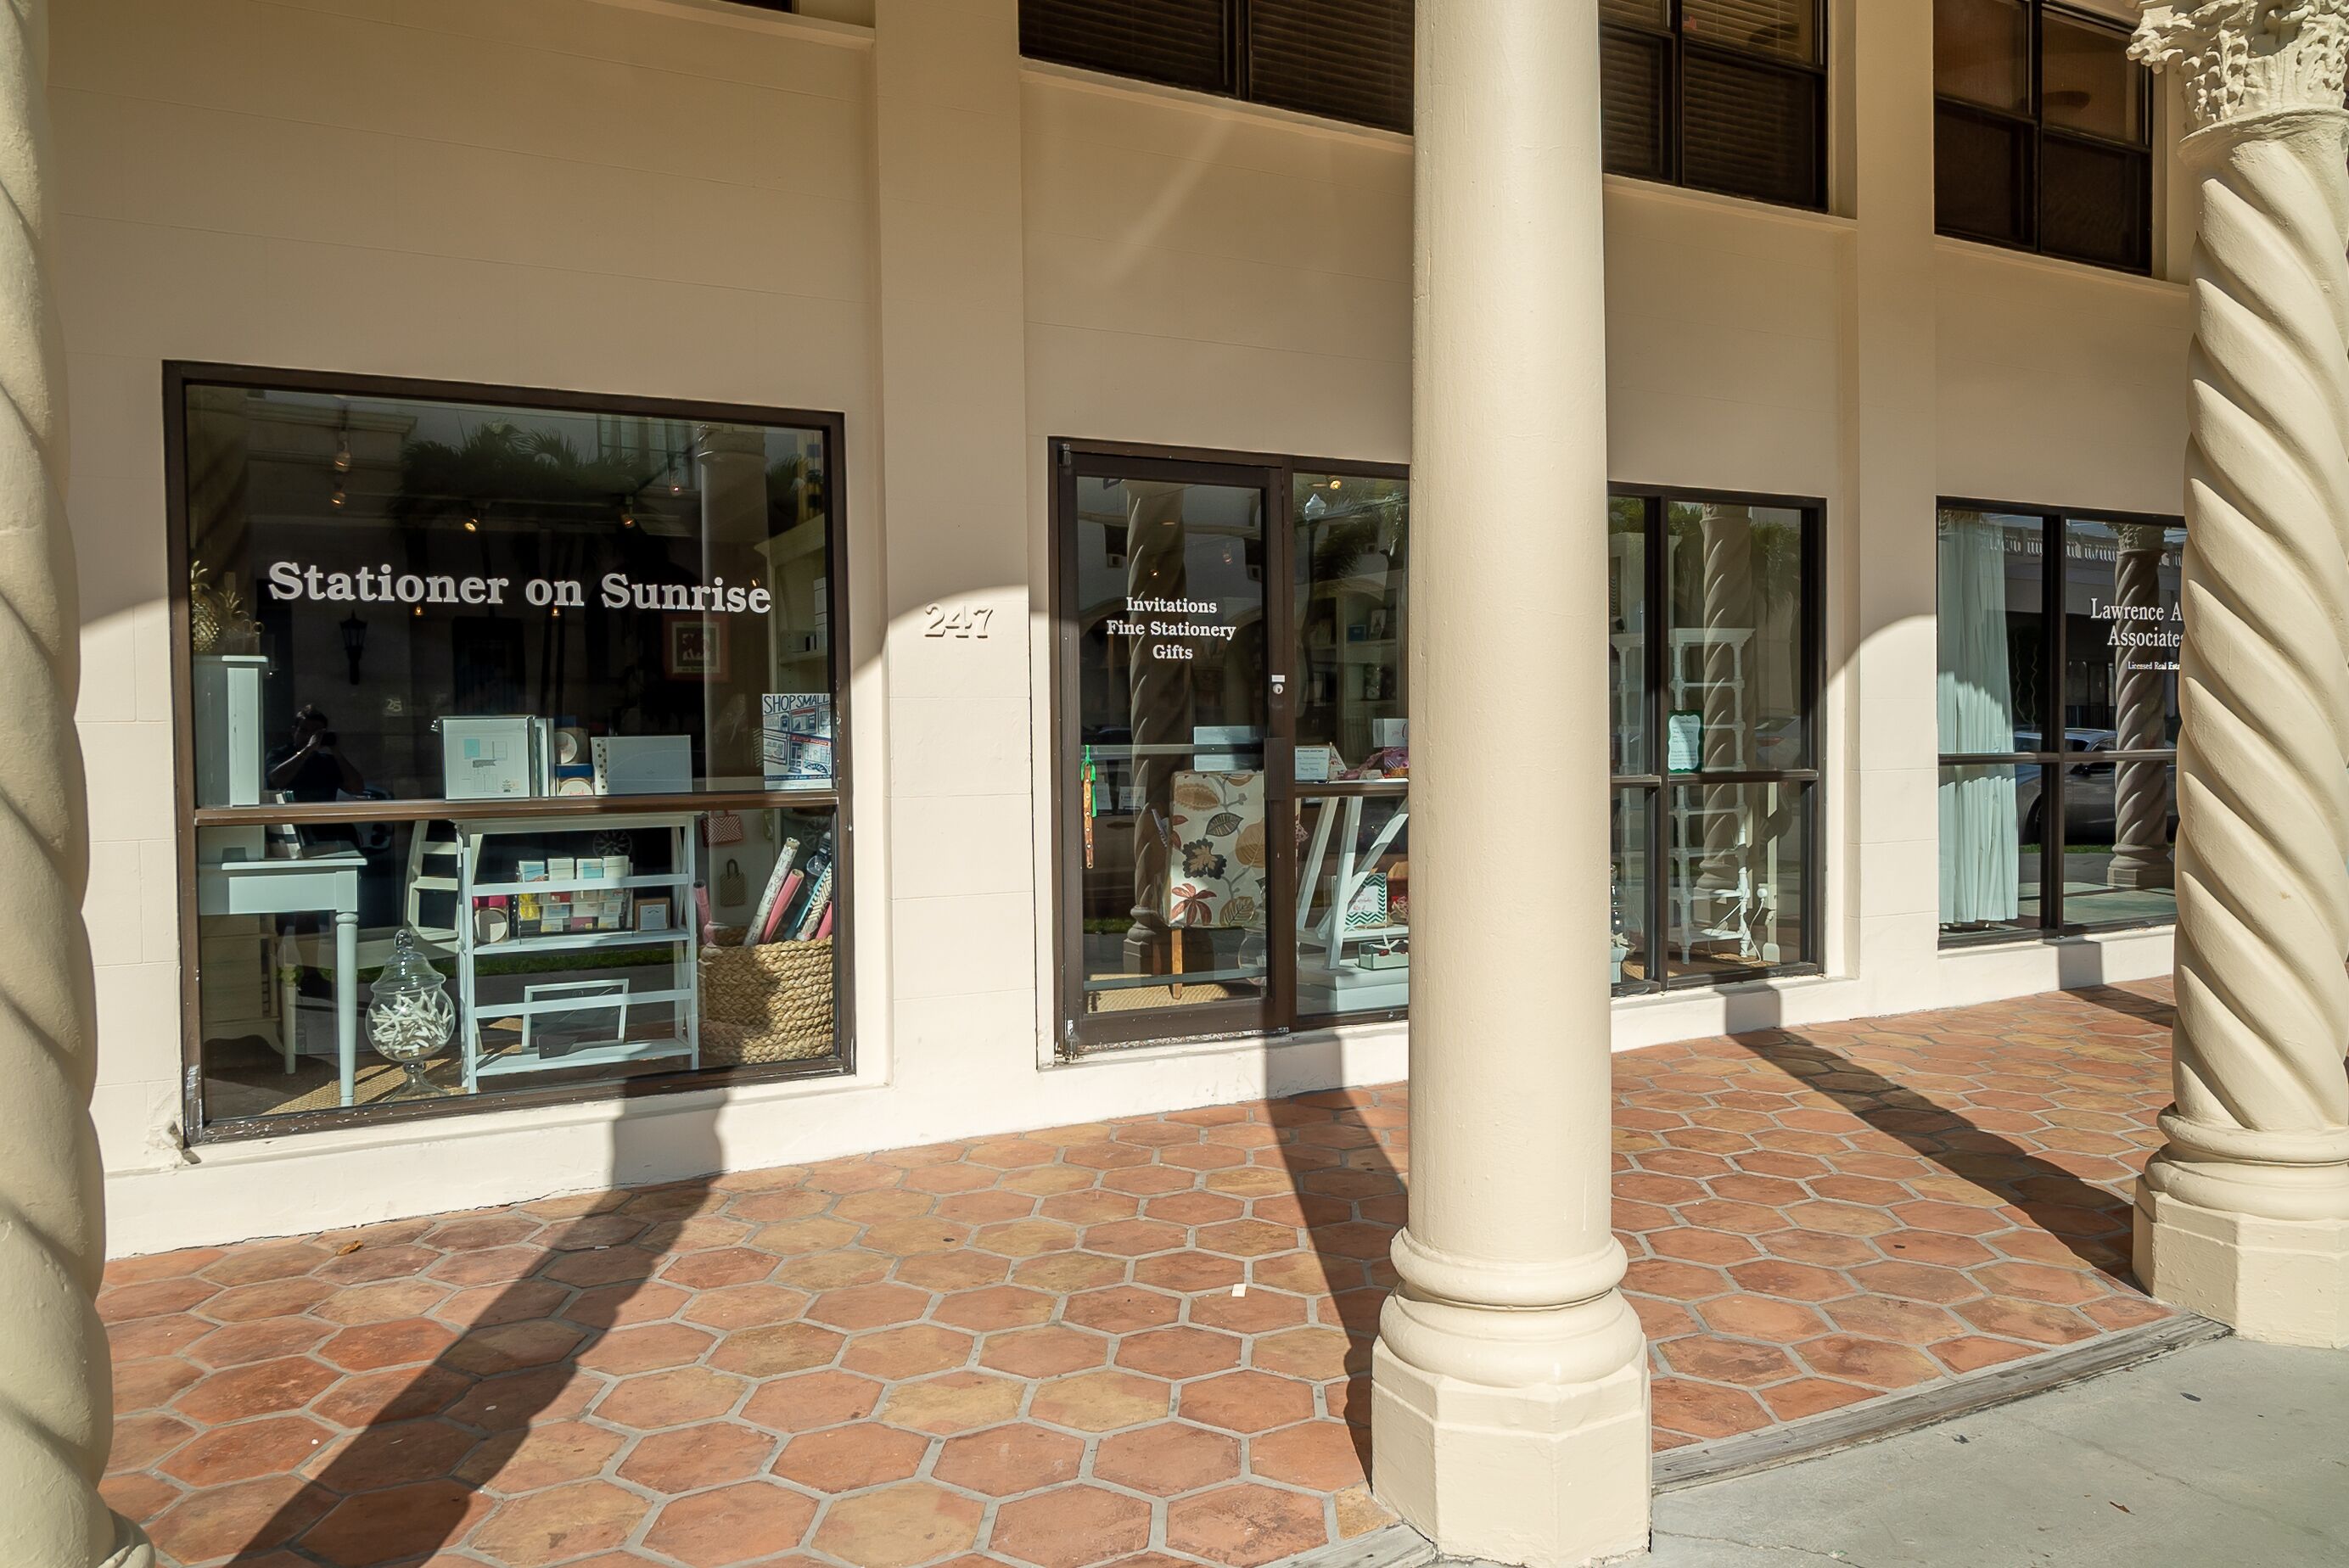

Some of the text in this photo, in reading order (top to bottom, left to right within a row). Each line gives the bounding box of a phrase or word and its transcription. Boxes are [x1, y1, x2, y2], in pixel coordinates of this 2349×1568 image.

[268, 562, 771, 613] Stationer on Sunrise
[1126, 596, 1218, 613] Invitations
[2090, 597, 2165, 621] Lawrence
[924, 602, 994, 639] 247
[1106, 619, 1237, 641] Fine Stationery
[1152, 644, 1194, 660] Gifts
[2128, 661, 2153, 670] Licensed
[2154, 661, 2167, 670] Real
[764, 694, 830, 714] SHOP SMALL
